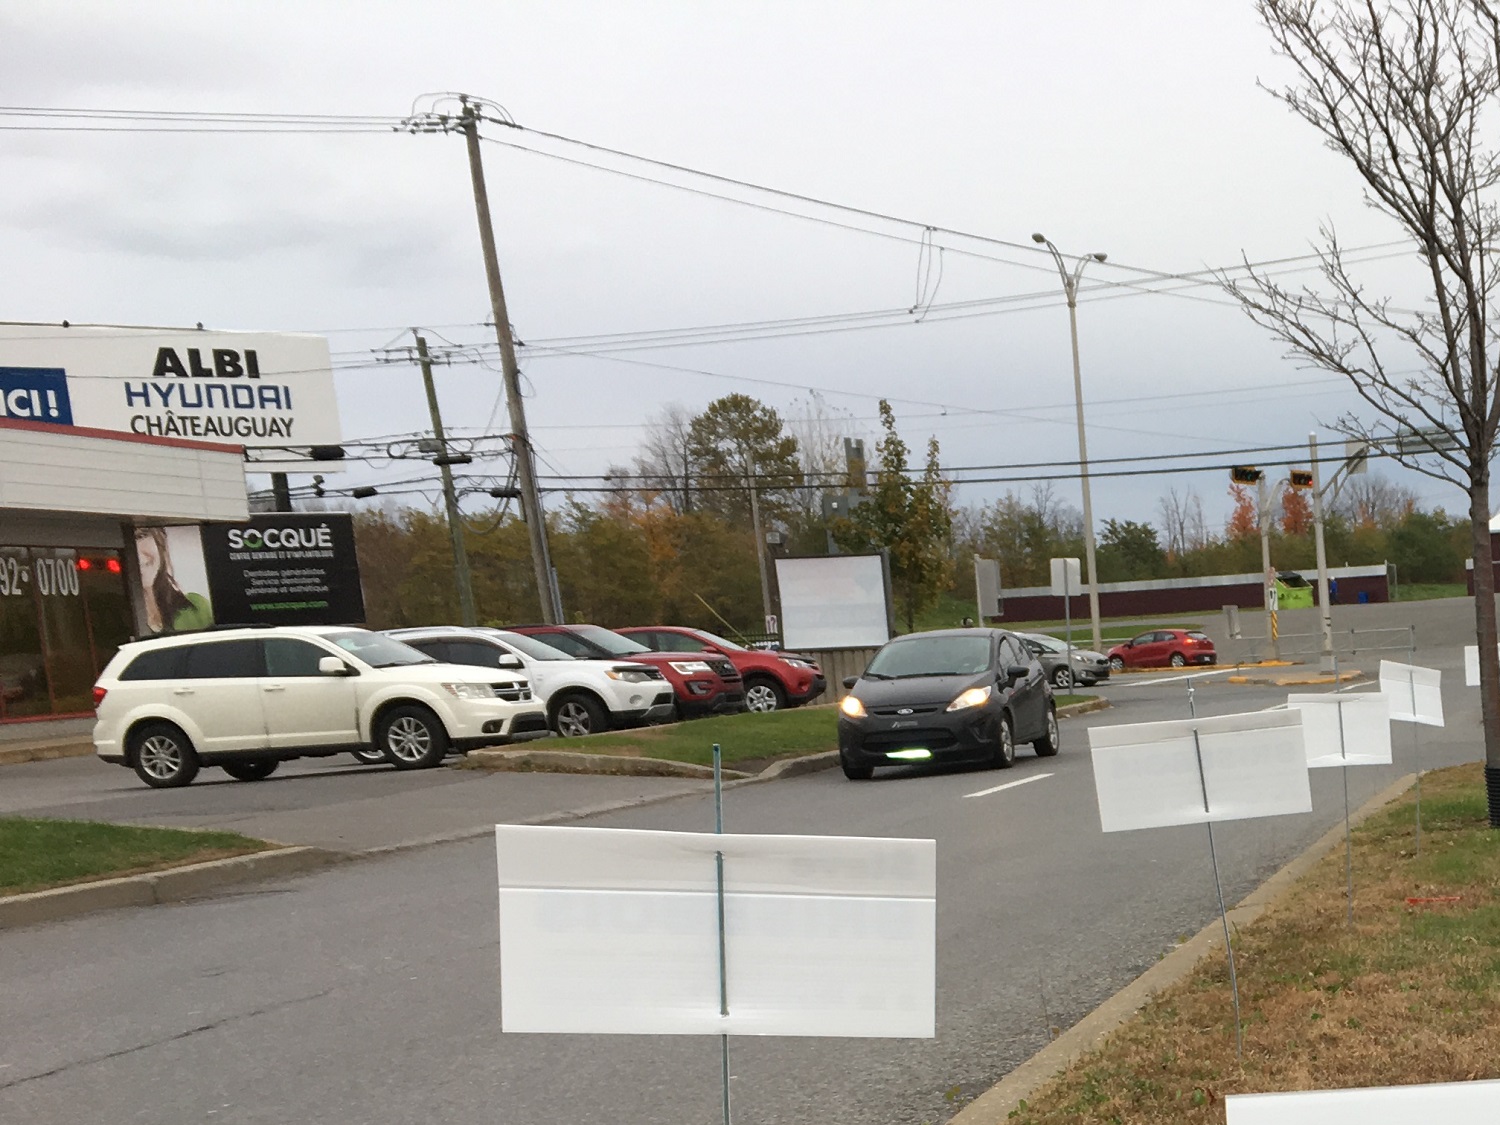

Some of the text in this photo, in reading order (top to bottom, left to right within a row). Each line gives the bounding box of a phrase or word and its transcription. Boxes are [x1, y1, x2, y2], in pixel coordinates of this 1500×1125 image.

[152, 346, 261, 379] ALBI
[124, 381, 293, 411] HYUNDAI
[130, 410, 294, 438] CHÂTEAUGUAY
[227, 522, 334, 549] SOCQUÉ
[36, 557, 80, 597] 0700
